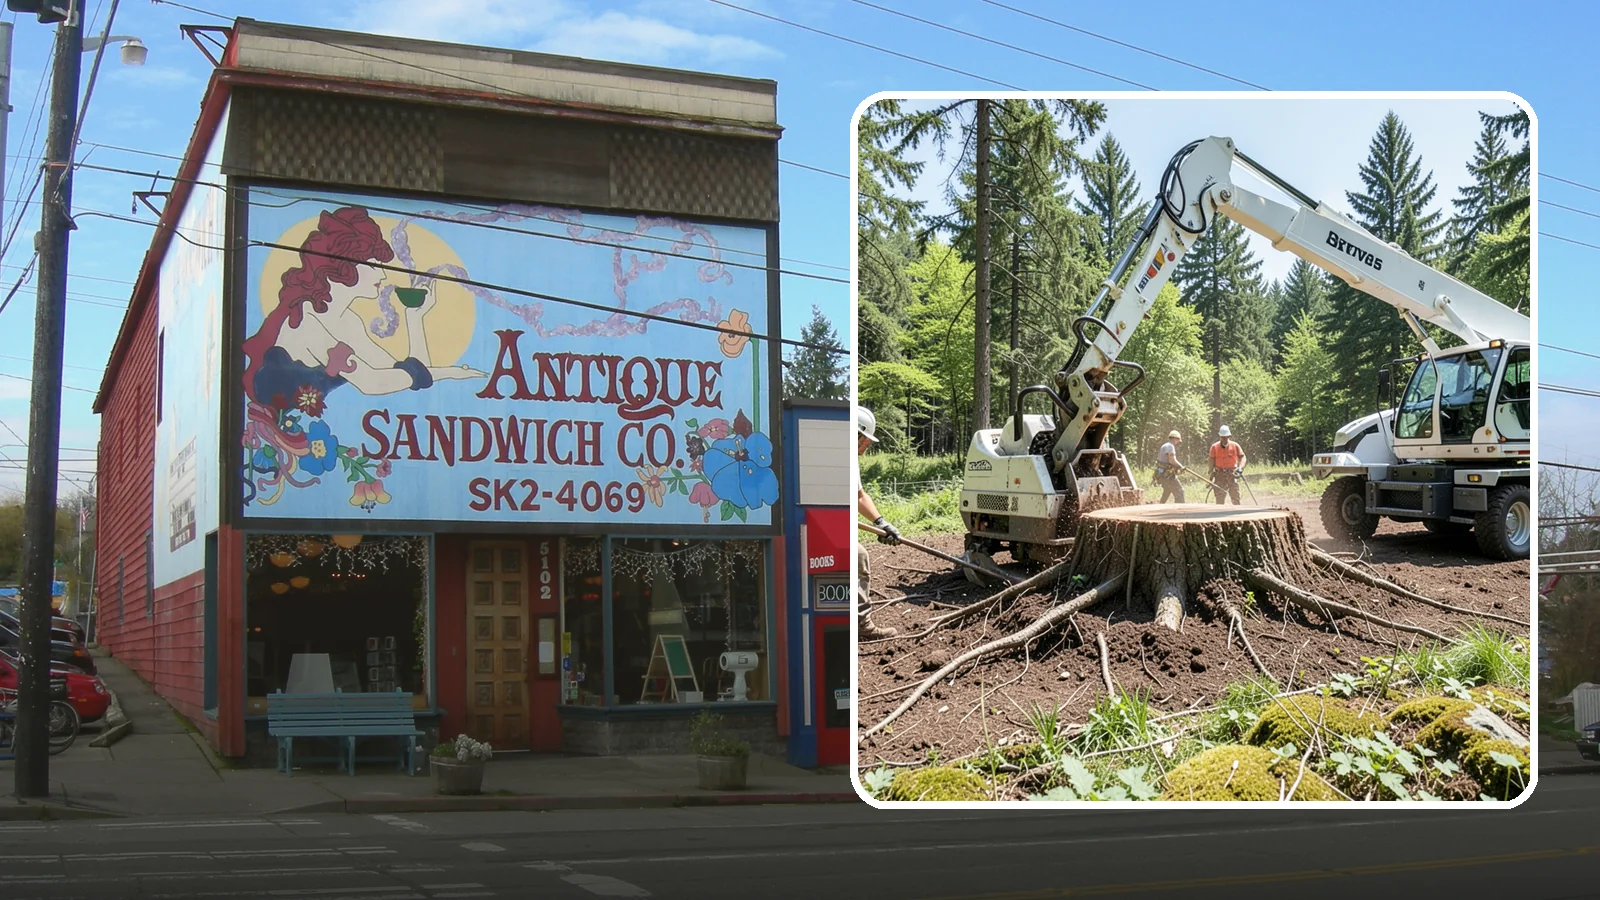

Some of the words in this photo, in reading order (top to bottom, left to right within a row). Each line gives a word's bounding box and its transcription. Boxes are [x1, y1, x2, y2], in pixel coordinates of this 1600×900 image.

[361, 408, 604, 467] SANDWICH
[616, 421, 685, 469] CO.
[468, 477, 646, 513] SK2-4069
[540, 541, 551, 600] 5102
[809, 555, 835, 569] BOOKS
